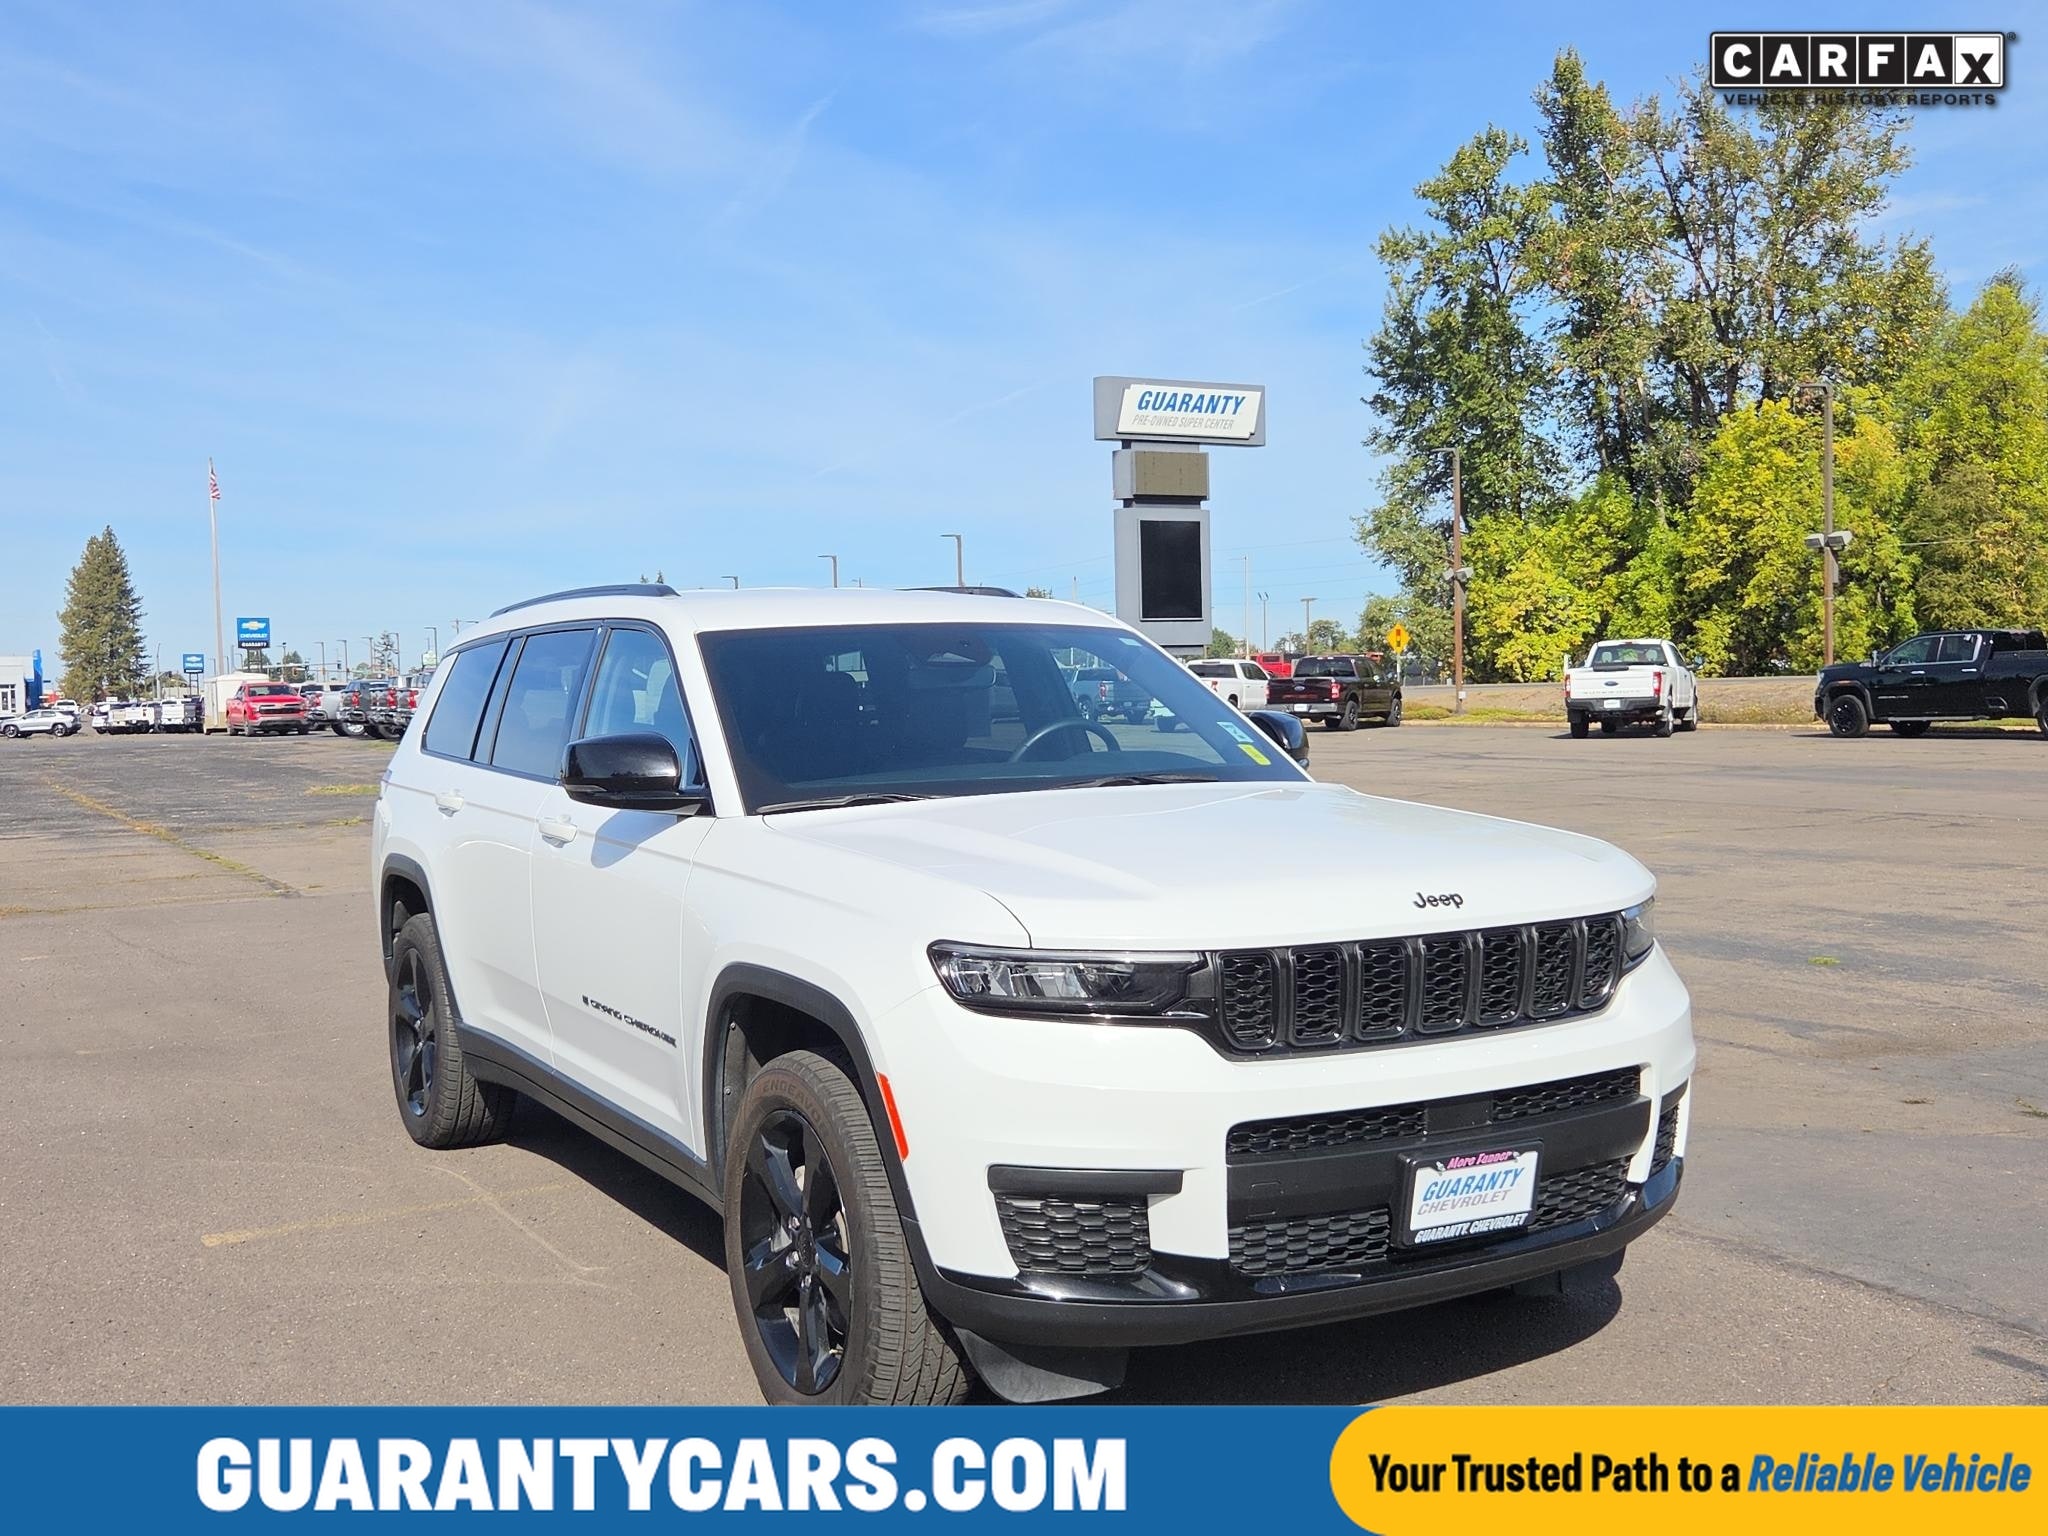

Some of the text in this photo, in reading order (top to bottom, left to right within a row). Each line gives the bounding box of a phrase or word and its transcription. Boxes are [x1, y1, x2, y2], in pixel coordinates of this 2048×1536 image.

[1137, 390, 1246, 415] GUARANTY
[1132, 414, 1235, 431] PRE-OWNED SUPER CENTER
[1413, 891, 1464, 909] Jeep
[1446, 1156, 1476, 1169] More
[1422, 1167, 1525, 1202] GUARANTY
[1417, 1189, 1513, 1216] CHEVROLET
[1414, 1212, 1529, 1244] GUARANTY CHEVROLET
